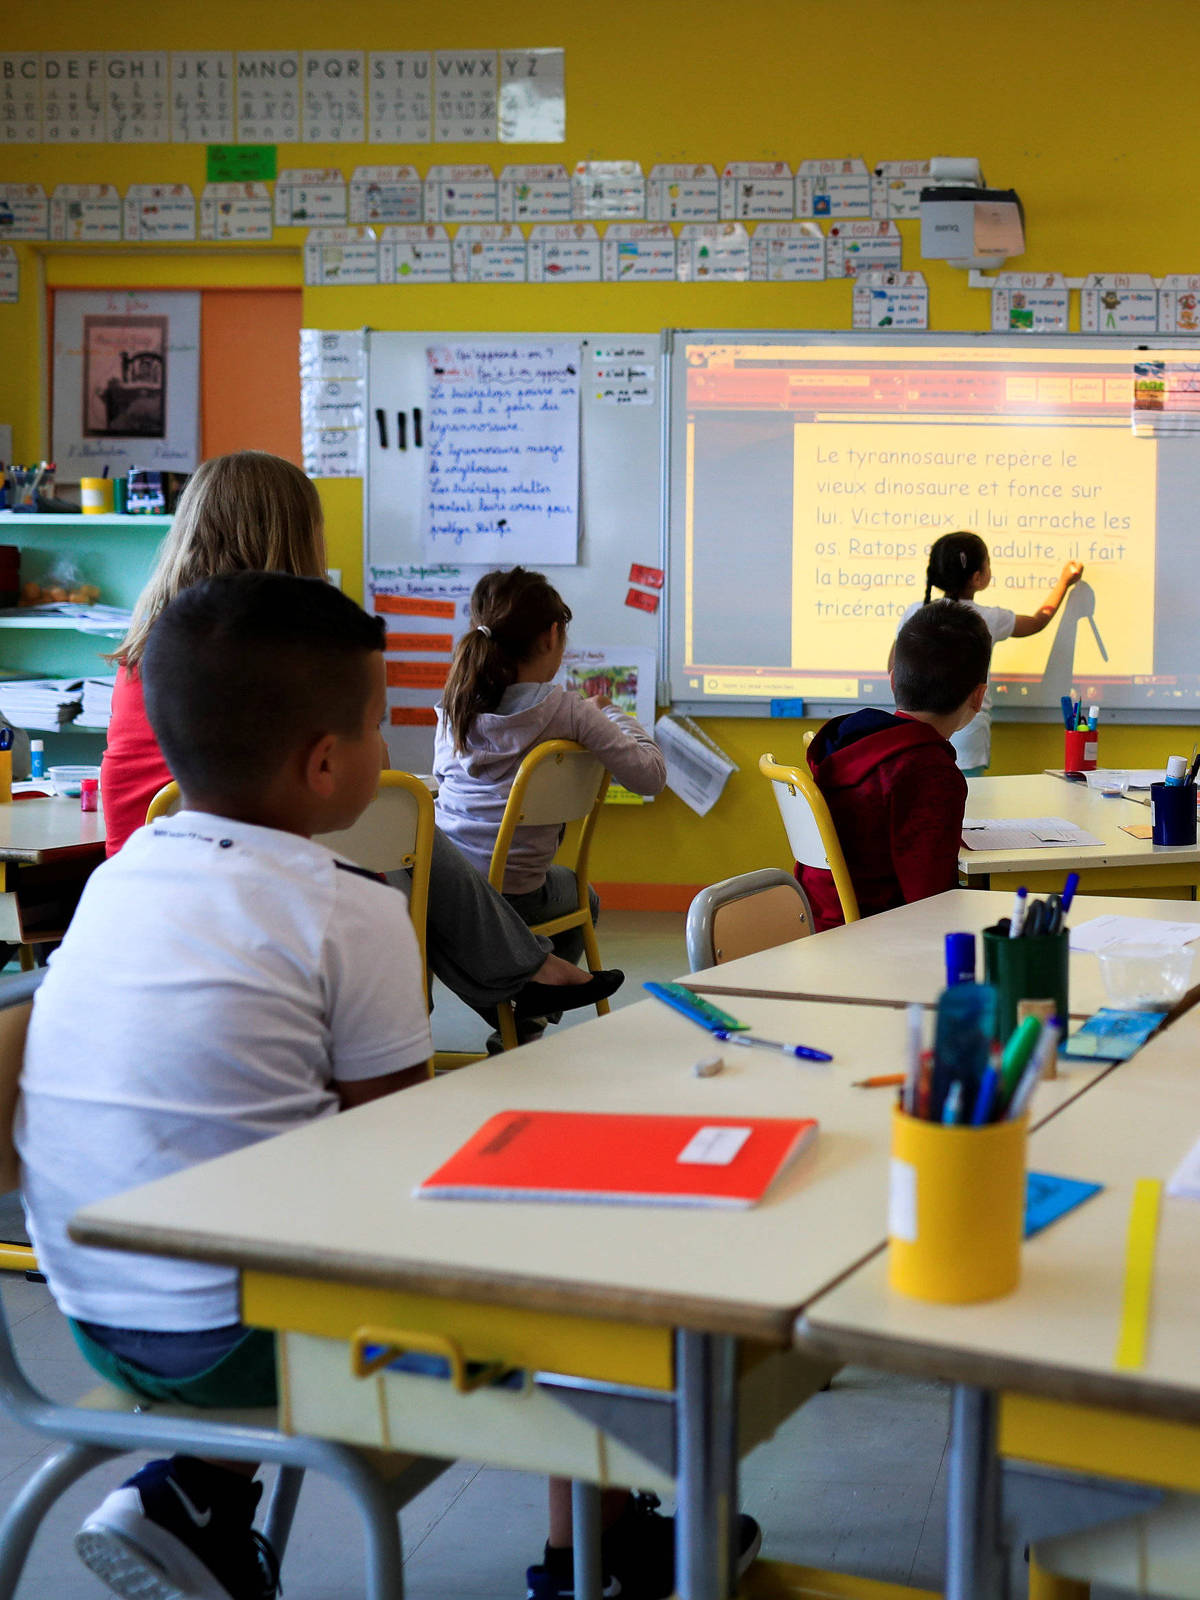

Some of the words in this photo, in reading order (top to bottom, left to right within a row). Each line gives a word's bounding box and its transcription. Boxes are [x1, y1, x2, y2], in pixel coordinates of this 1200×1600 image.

[817, 447, 838, 464] Le
[848, 448, 977, 470] tyrannosaure
[985, 449, 1053, 472] repère
[1061, 449, 1078, 467] le
[817, 479, 866, 496] vieux
[874, 477, 969, 497] dinosaure
[978, 481, 999, 497] et
[1008, 479, 1063, 498] fonce
[1071, 482, 1103, 498] sur
[816, 506, 843, 526] lui.
[851, 506, 961, 529] Victorieux,
[968, 508, 979, 527] il
[987, 509, 1008, 527] lui
[1017, 509, 1096, 529] arrache
[1104, 511, 1131, 530] les
[815, 541, 842, 557] os.
[849, 538, 917, 560] Ratops
[993, 540, 1061, 562] adulte,
[1068, 541, 1080, 560] il
[1088, 541, 1126, 560] fait
[816, 568, 831, 586] la
[838, 567, 916, 591] bagarre
[1004, 572, 1058, 590] autre
